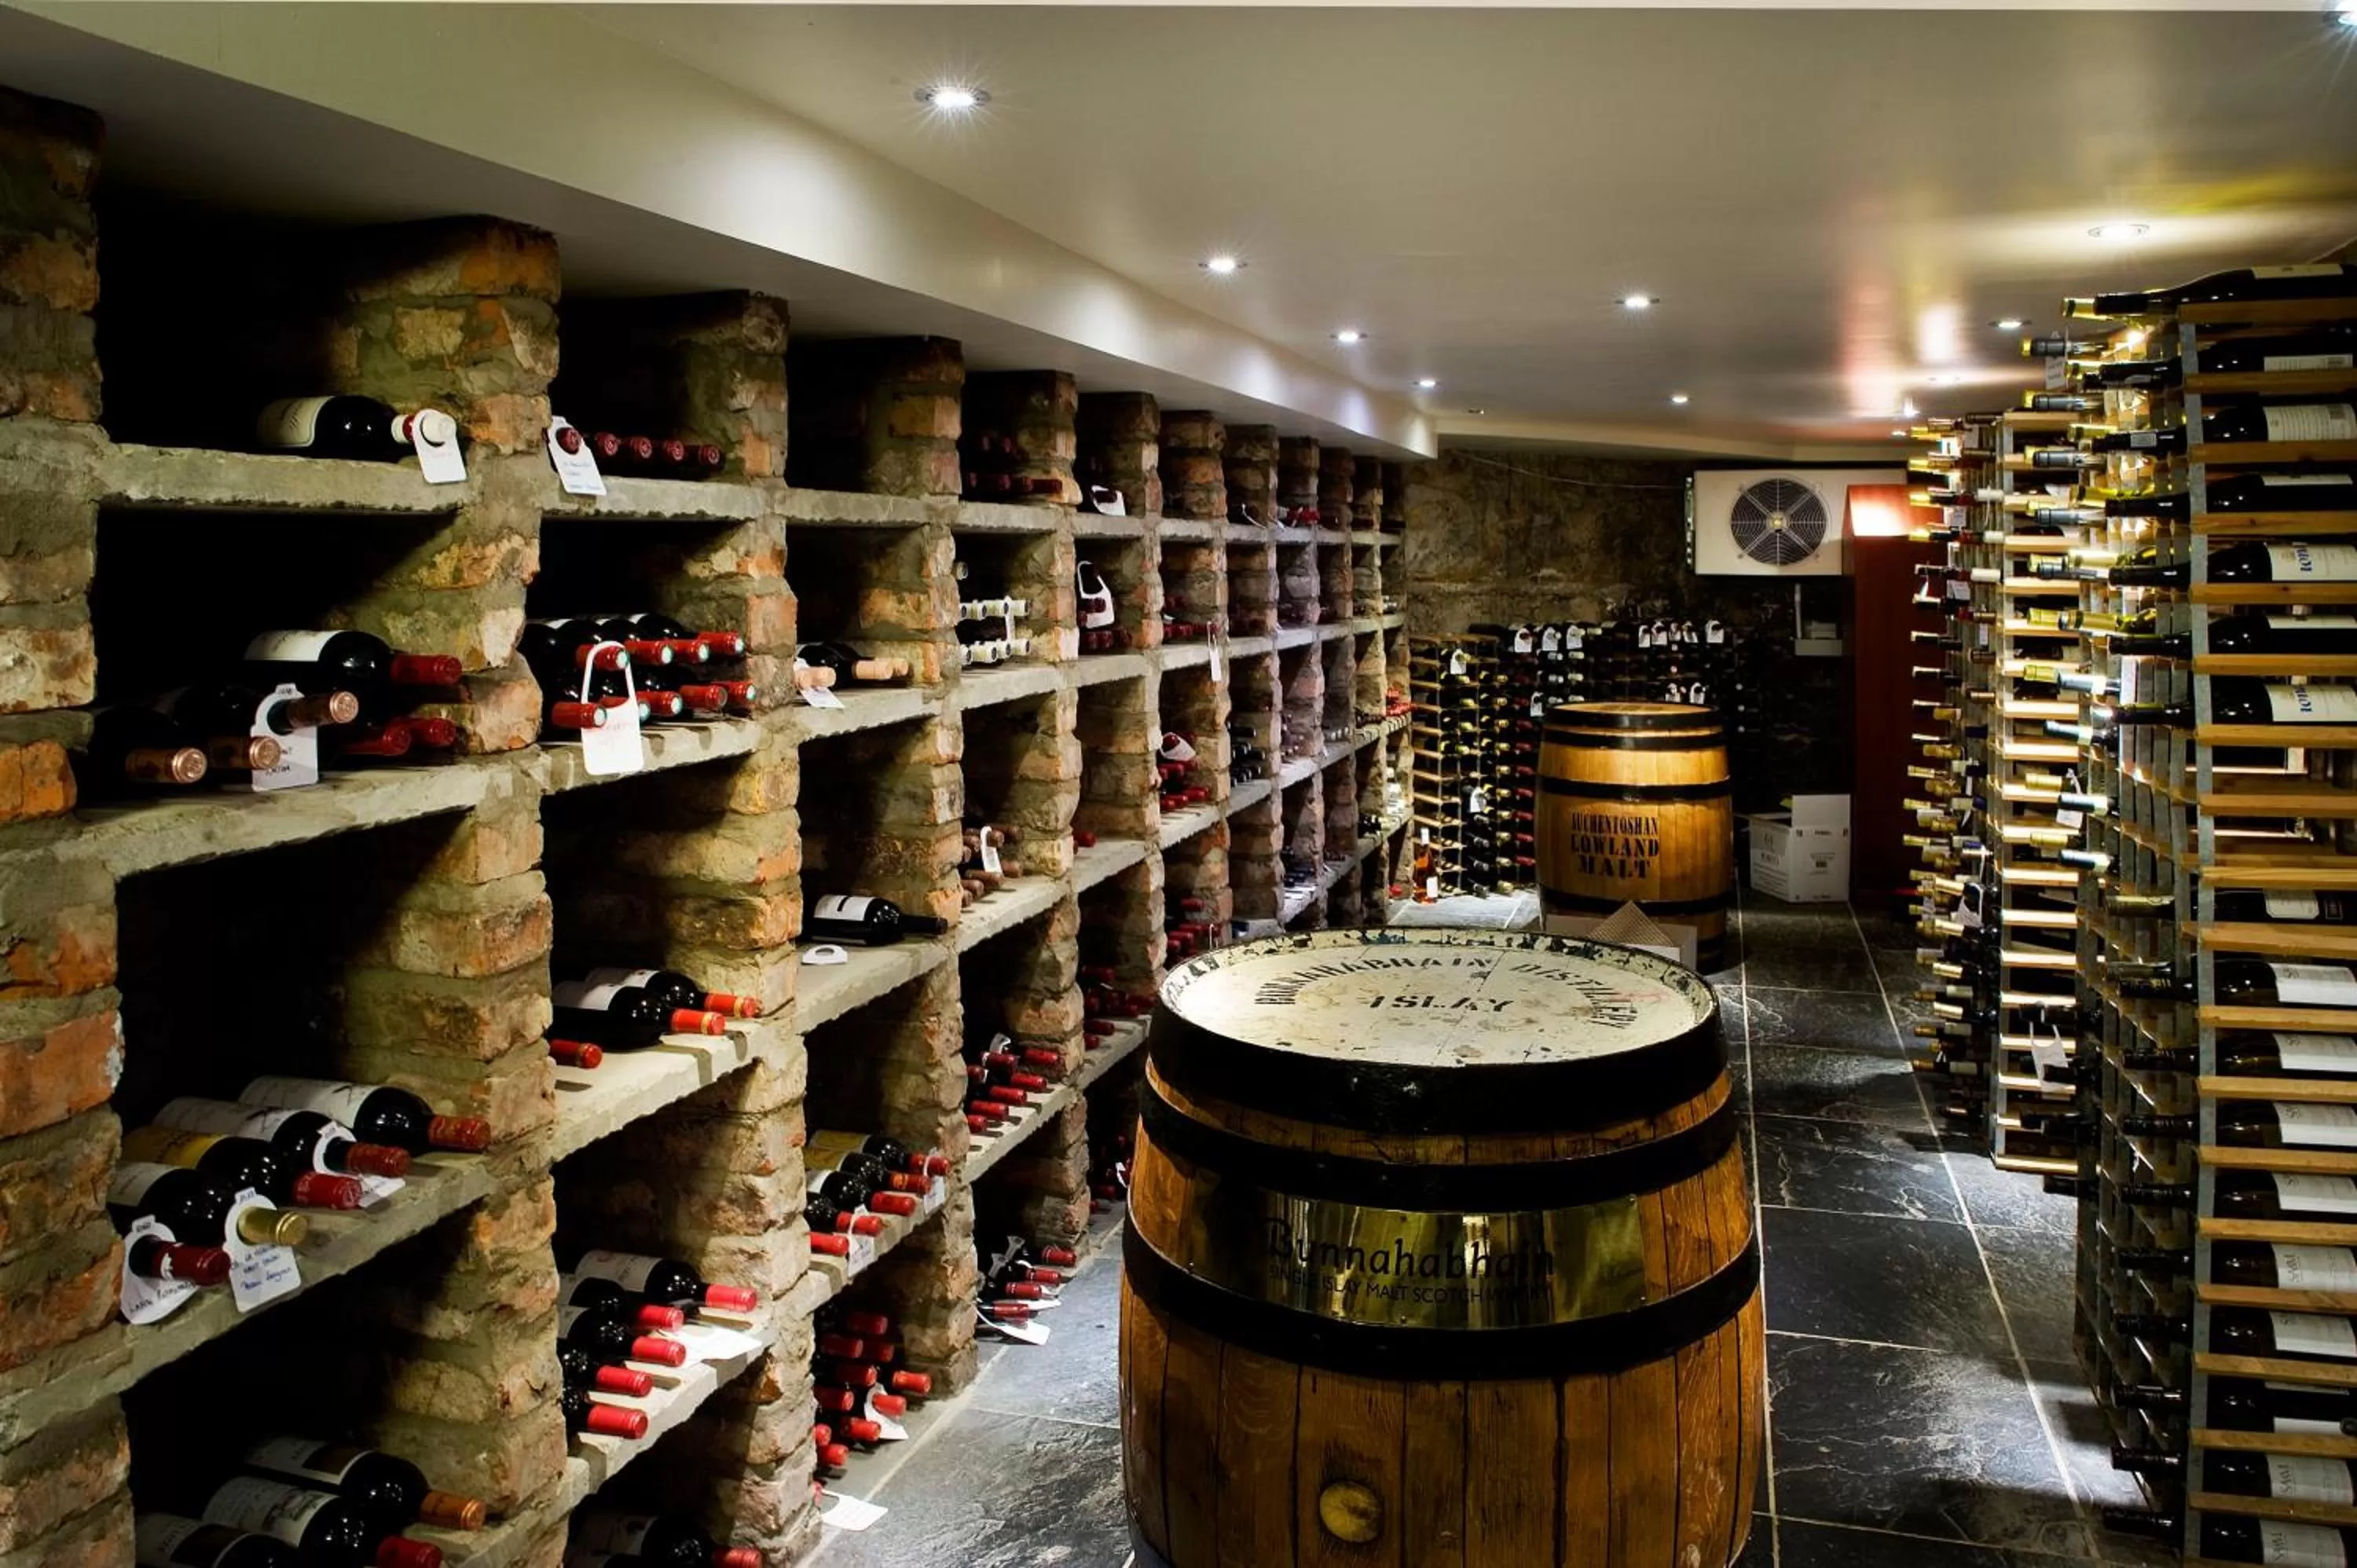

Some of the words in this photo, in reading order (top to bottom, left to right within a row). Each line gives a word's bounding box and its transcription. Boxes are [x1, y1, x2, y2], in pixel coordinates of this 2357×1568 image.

[1571, 812, 1659, 835] AUCHENTOSHAN
[1571, 834, 1659, 857] LOWLAND
[1578, 855, 1651, 879] MALT
[1369, 995, 1514, 1012] ISLAY
[1260, 1217, 1554, 1279] Bunnahabhain
[1322, 1274, 1361, 1295] ISLAY
[1366, 1280, 1409, 1300] MALT
[1413, 1286, 1483, 1304] SCOTCH
